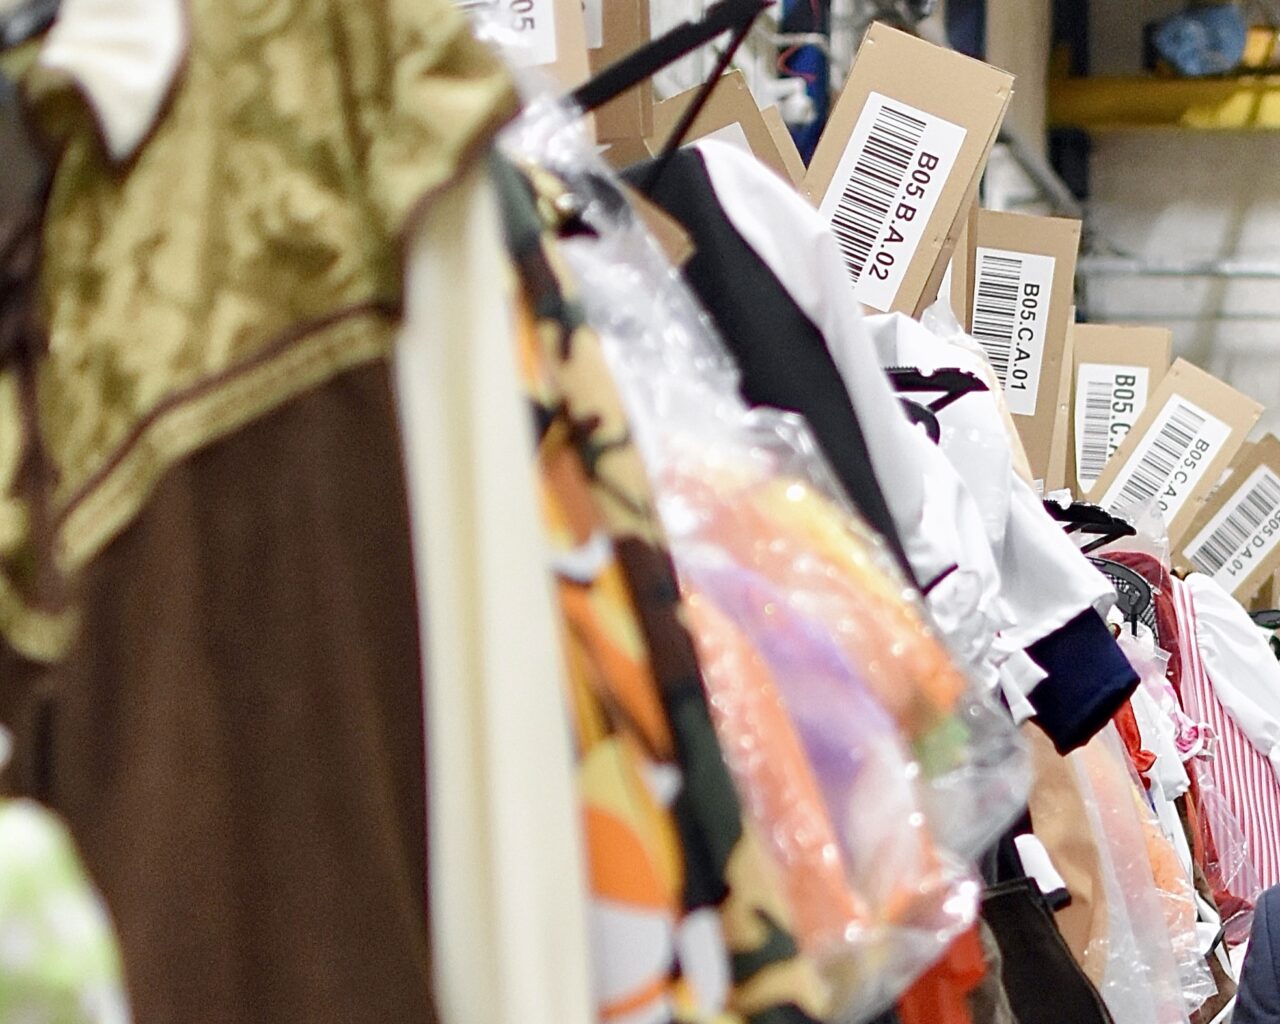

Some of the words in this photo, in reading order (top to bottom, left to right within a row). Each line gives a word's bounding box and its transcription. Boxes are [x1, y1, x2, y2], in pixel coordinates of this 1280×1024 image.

[869, 151, 940, 281] B05.B.A.02
[1011, 283, 1040, 391] B05.C.A.01
[1153, 438, 1210, 514] B05.C.A.0
